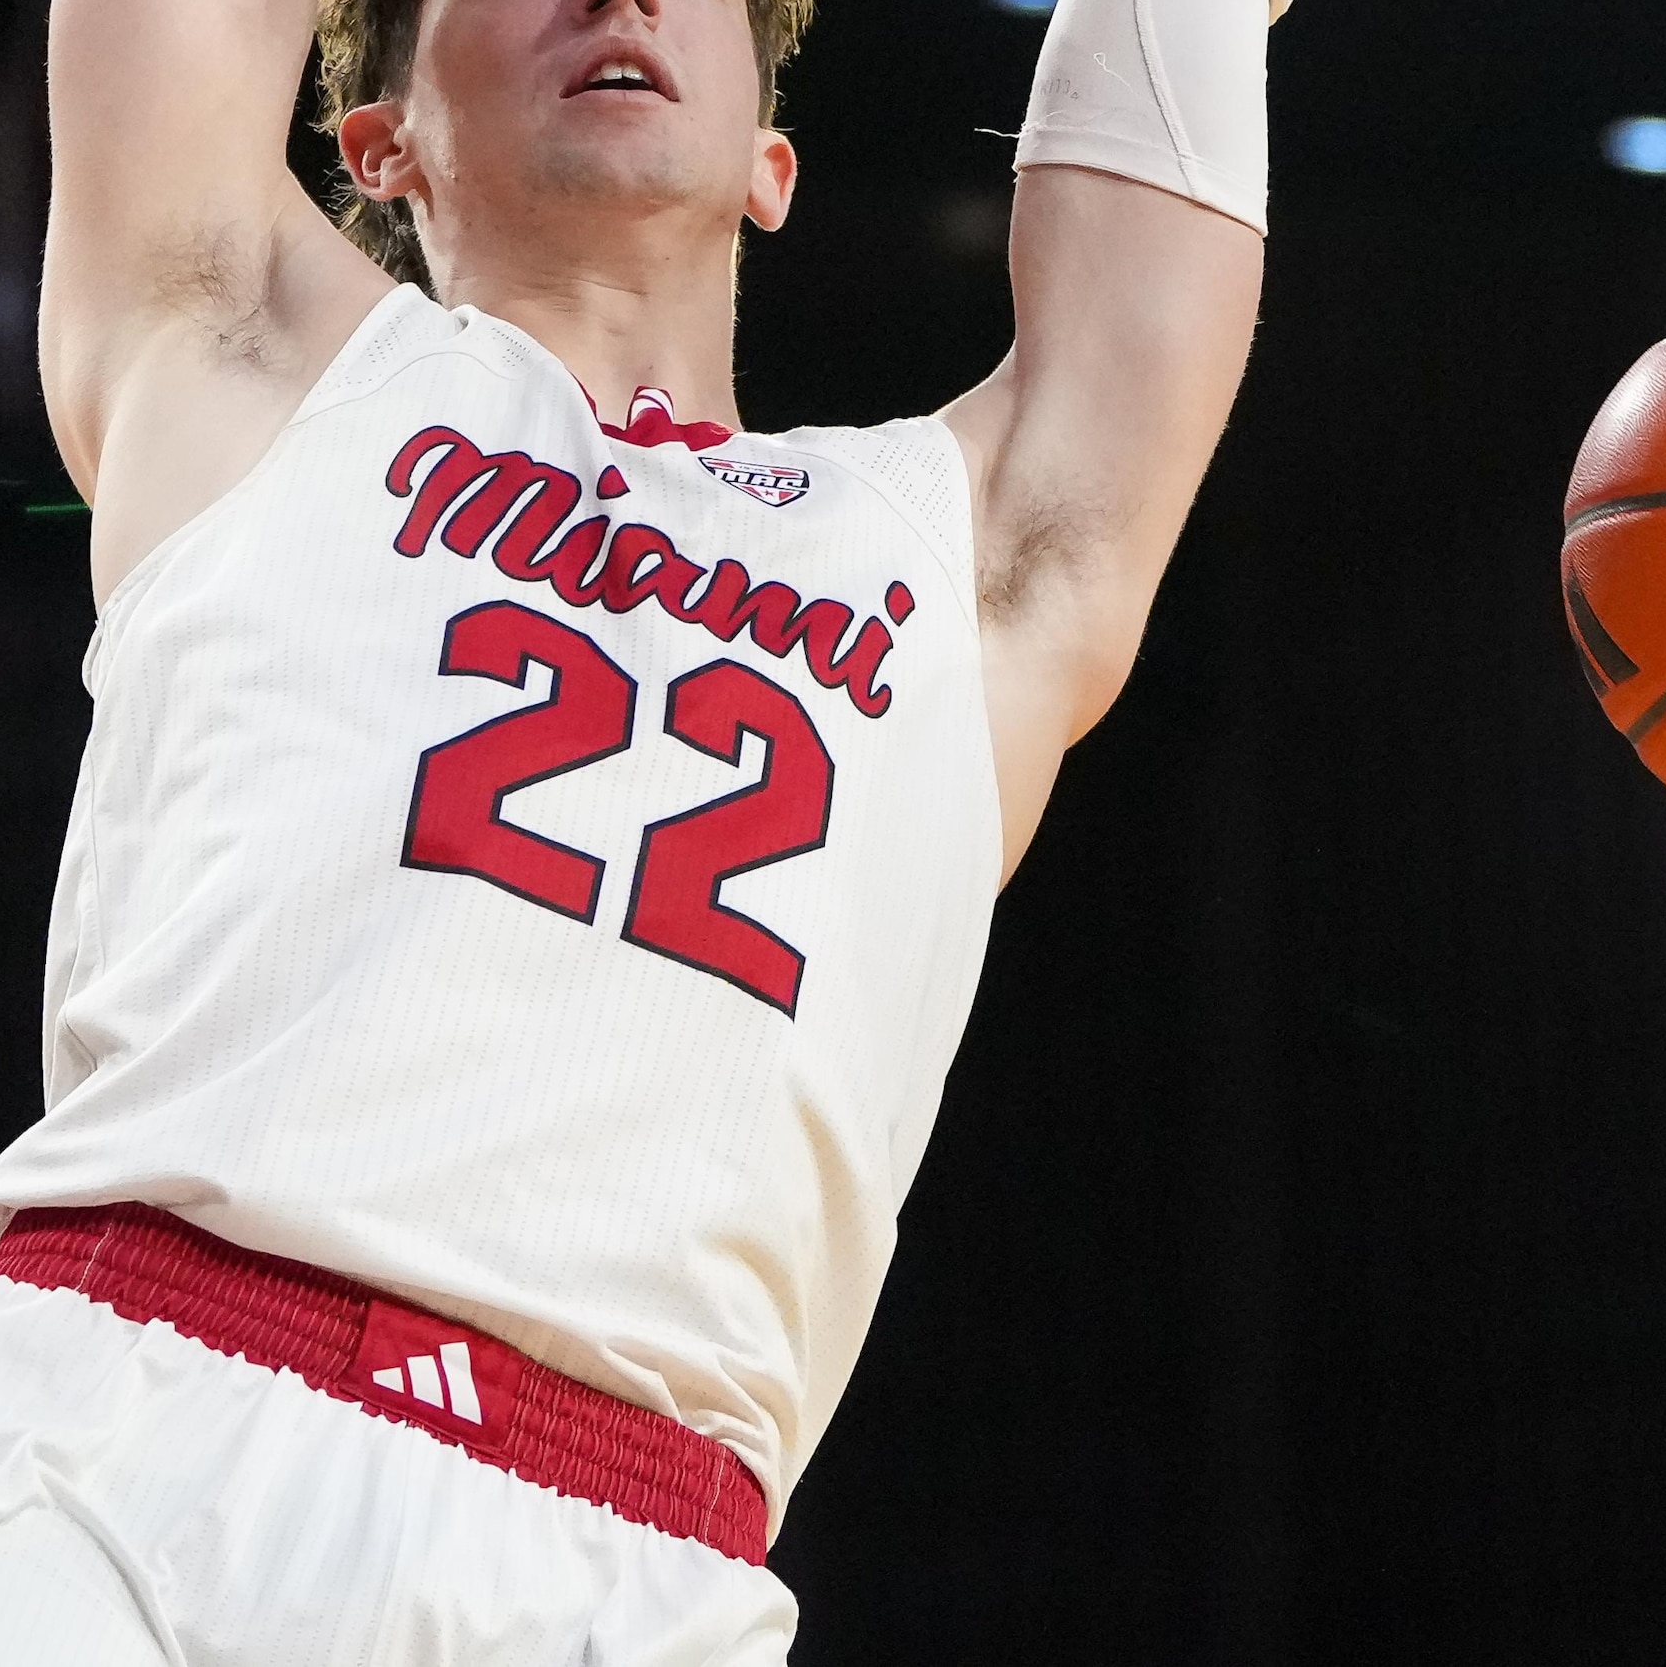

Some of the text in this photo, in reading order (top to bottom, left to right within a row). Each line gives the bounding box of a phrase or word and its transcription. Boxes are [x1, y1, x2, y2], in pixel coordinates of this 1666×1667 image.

[385, 425, 916, 719] Miami
[714, 468, 808, 490] MAC
[399, 599, 836, 1022] 22
